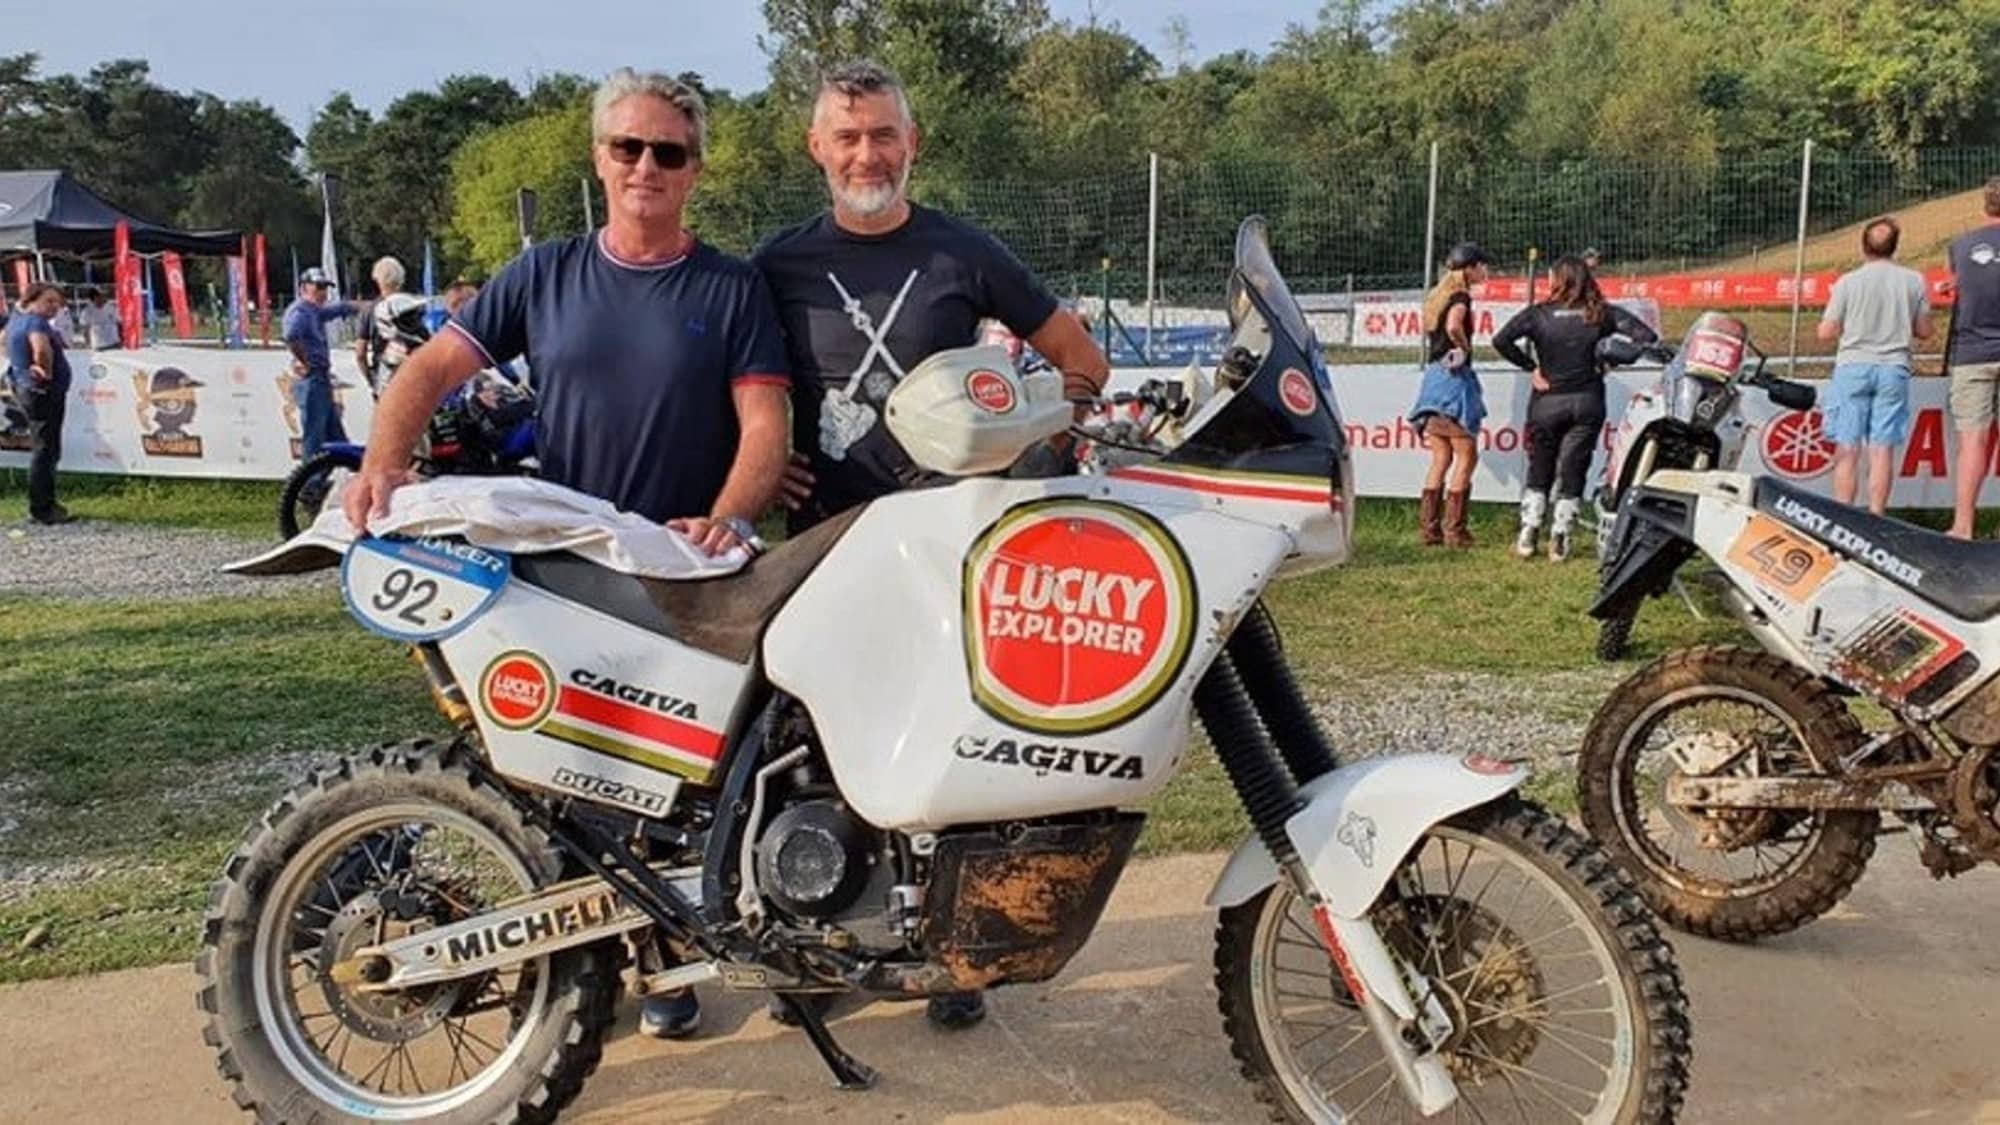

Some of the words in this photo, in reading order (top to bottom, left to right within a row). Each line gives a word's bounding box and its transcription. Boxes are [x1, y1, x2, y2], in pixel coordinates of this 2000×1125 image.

[1747, 534, 1814, 587] 49
[1774, 496, 1832, 533] LUCKY
[1829, 523, 1923, 587] EXPLORER
[372, 568, 439, 626] 92
[988, 561, 1154, 622] LUCKY
[987, 609, 1146, 657] EXPLORER
[570, 669, 698, 720] CAGIVA
[953, 735, 1145, 780] CAGIVA
[551, 766, 667, 813] DUCATI
